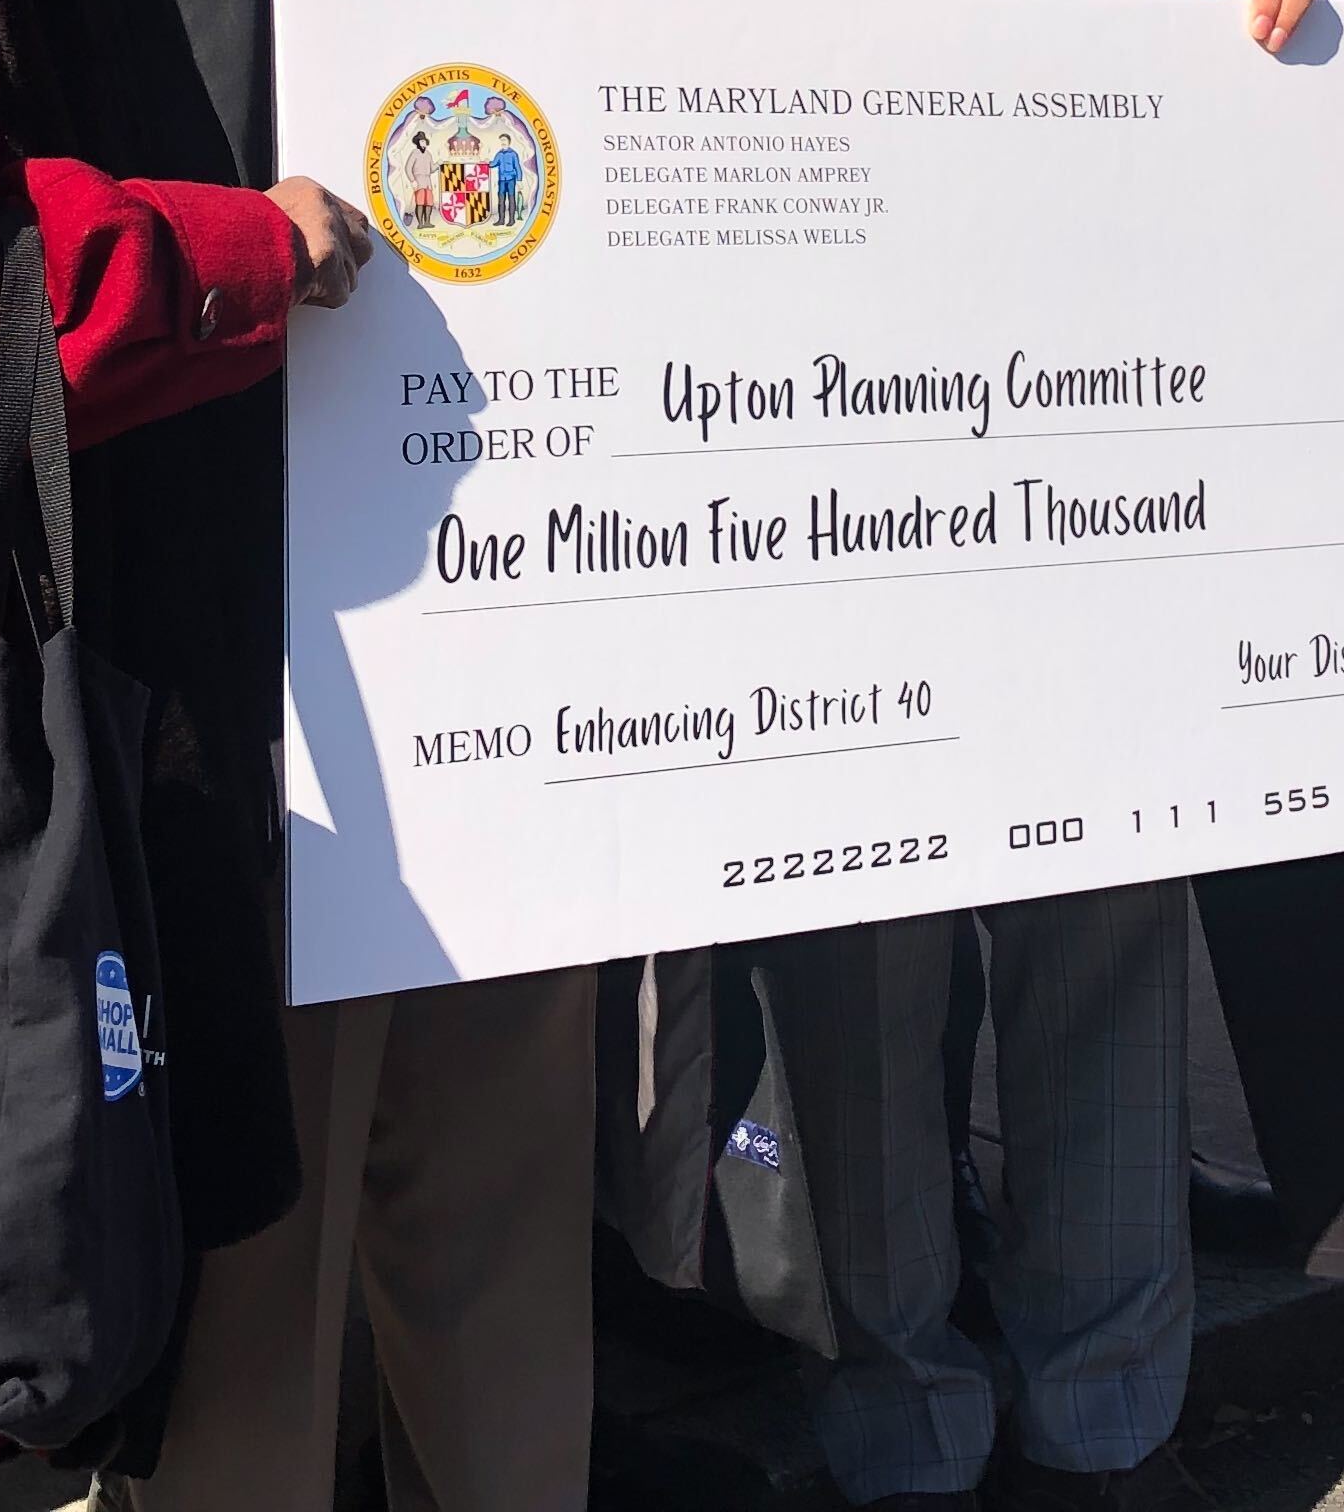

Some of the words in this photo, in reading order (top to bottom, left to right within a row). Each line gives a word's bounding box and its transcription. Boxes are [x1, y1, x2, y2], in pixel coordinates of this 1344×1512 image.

[385, 69, 470, 120] VOLVNTATIS
[597, 84, 668, 113] THE
[676, 86, 853, 116] MARYLAND
[862, 89, 1005, 118] GENERAL
[1011, 91, 1164, 120] ASSEMBLY
[603, 134, 696, 152] SENATOR
[699, 135, 785, 153] ANTONIO
[789, 136, 851, 153] HAYES
[532, 118, 557, 217] CORONASTI
[604, 166, 709, 184] DELEGATE
[713, 166, 792, 184] MARLON
[796, 166, 872, 183] AMPREY
[606, 198, 710, 216] DELEGATE
[714, 197, 780, 215] FRANK
[783, 197, 859, 215] CONWAY
[863, 197, 889, 218] JR.
[509, 235, 537, 264] NOS
[607, 229, 711, 248] DELEGATE
[714, 228, 800, 246] MELISSA
[802, 227, 867, 245] WELLS
[454, 267, 482, 279] 1632
[399, 372, 475, 406] PAY
[483, 368, 535, 403] TO
[543, 366, 621, 400] THE
[662, 360, 795, 443] Upton
[811, 353, 991, 439] Planning
[1006, 349, 1207, 410] Committee
[401, 427, 537, 466] ORDER
[545, 424, 595, 458] OF
[436, 512, 526, 585] One
[547, 502, 688, 575] Million
[706, 495, 788, 565] Five
[806, 487, 998, 562] Hundred
[1012, 477, 1207, 547] Thousand
[1238, 639, 1299, 686] Your
[556, 703, 735, 760] Enhancing
[748, 683, 883, 736] District
[896, 679, 932, 720] 40
[412, 723, 532, 768] MEMO
[722, 833, 949, 889] 22222222
[1264, 784, 1330, 817] 555
[98, 998, 133, 1027] HOP
